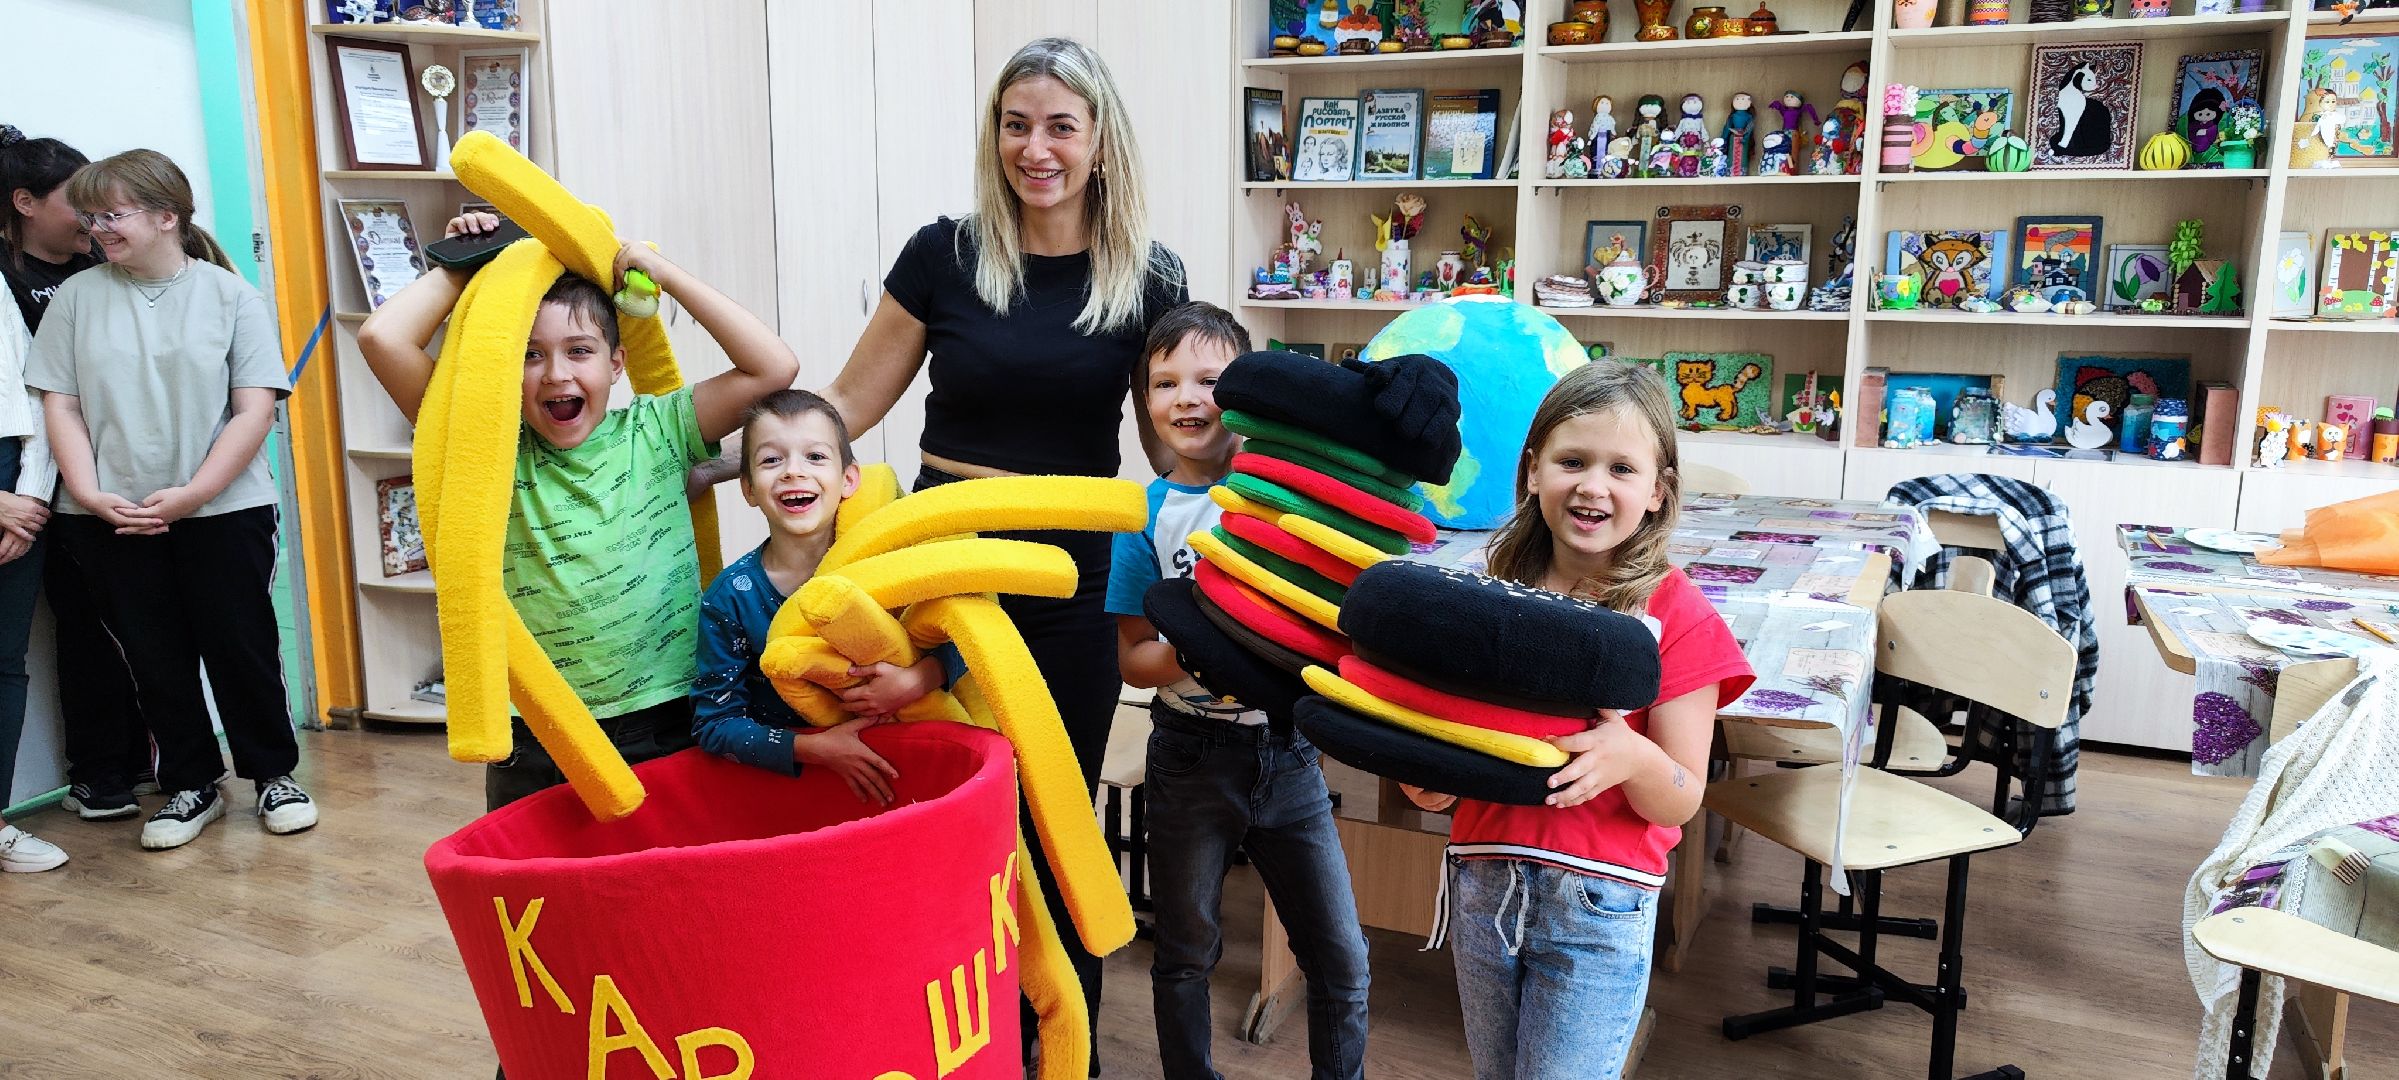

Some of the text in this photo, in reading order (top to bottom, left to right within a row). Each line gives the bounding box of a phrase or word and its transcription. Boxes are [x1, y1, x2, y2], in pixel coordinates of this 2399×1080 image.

[1312, 108, 1351, 116] РИСОВАТЬ
[1304, 114, 1356, 129] ПОРТРЕТ
[572, 530, 592, 538] STAY
[550, 552, 570, 562] VIBES
[564, 554, 582, 564] ONLY
[576, 634, 596, 645] STAY
